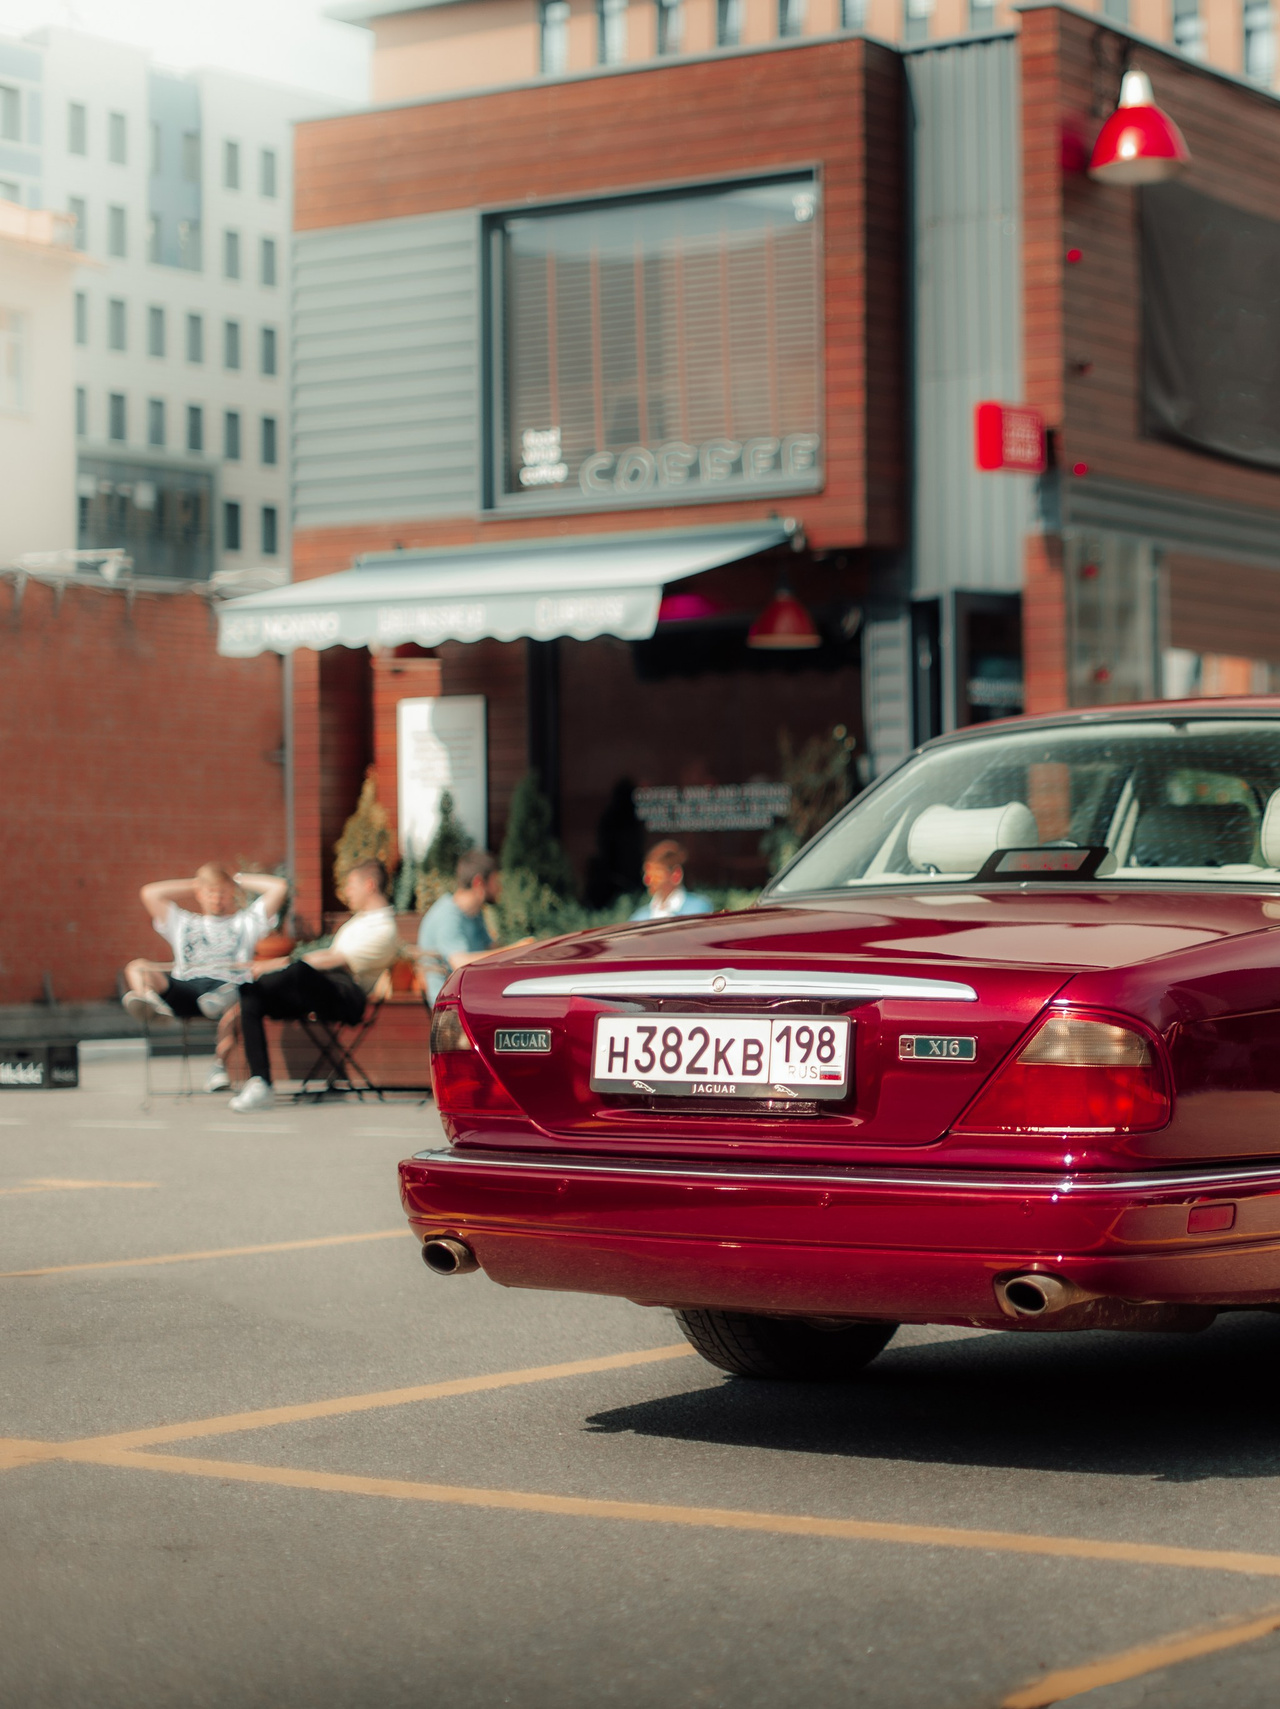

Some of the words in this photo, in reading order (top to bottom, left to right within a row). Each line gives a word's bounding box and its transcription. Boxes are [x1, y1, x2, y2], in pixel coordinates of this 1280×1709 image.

[579, 434, 819, 495] COFFEE
[498, 1033, 547, 1049] JAGUAR
[775, 1025, 836, 1064] 198
[929, 1040, 960, 1056] XJ6
[788, 1065, 818, 1079] RUS
[692, 1083, 736, 1094] JAGUAR
